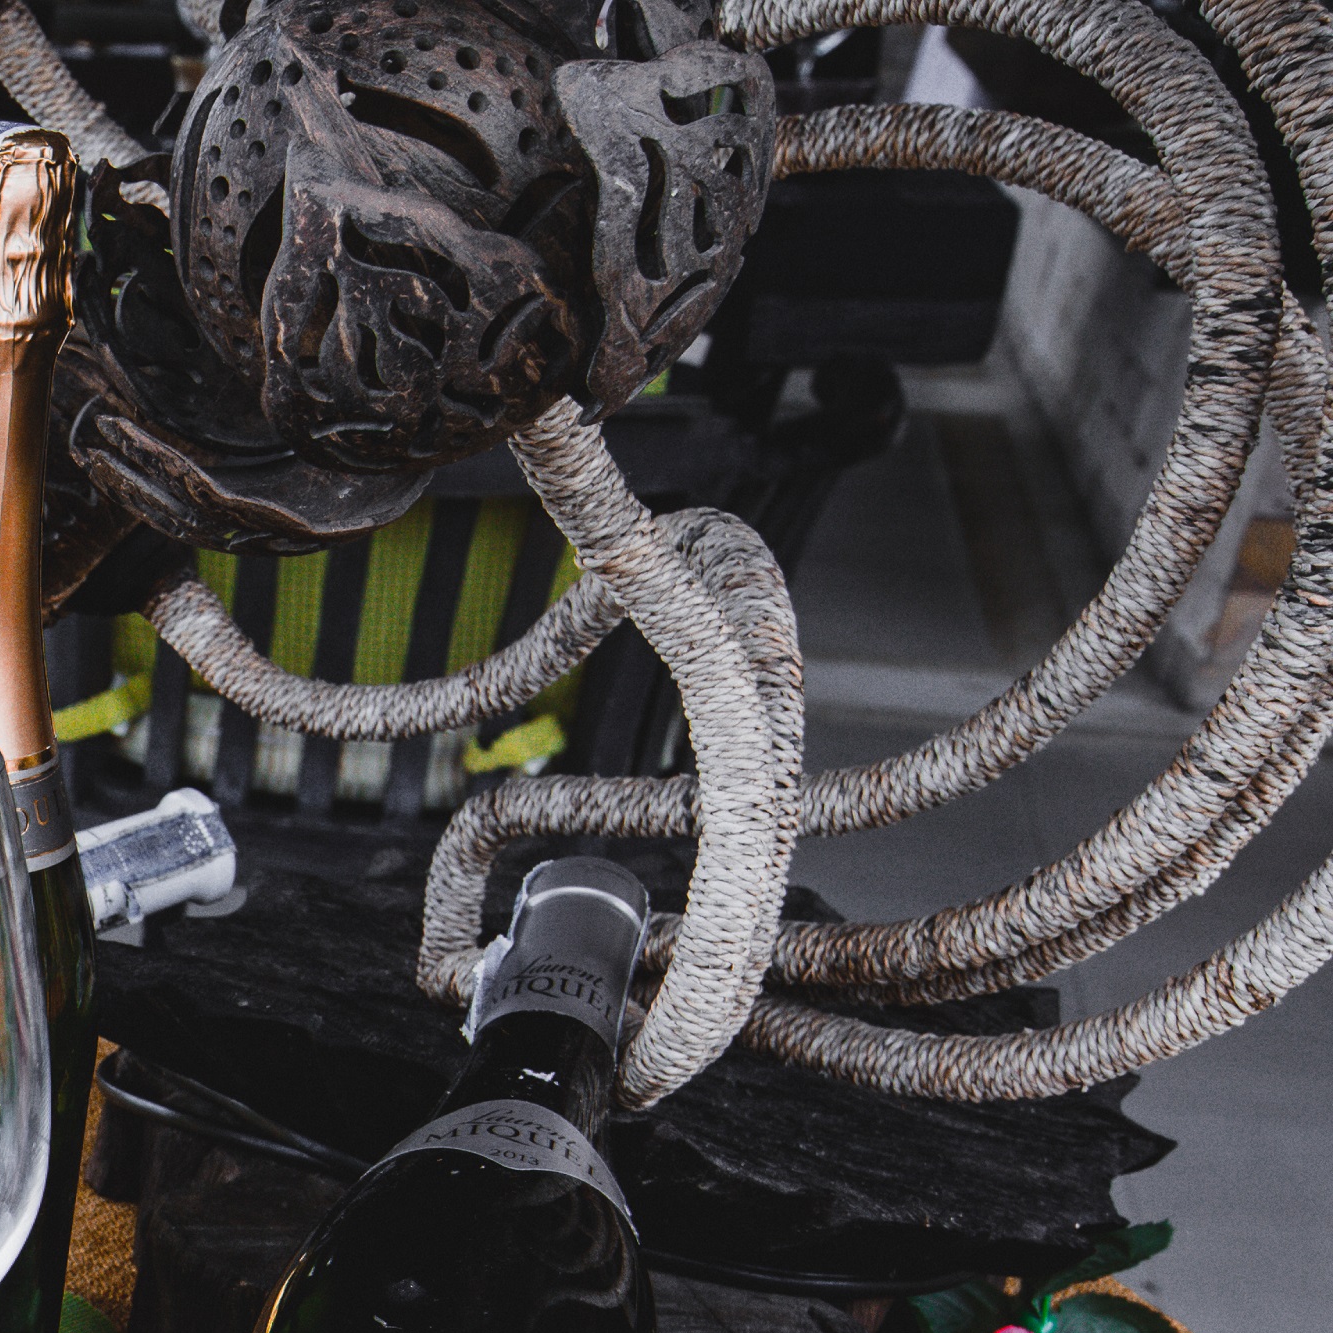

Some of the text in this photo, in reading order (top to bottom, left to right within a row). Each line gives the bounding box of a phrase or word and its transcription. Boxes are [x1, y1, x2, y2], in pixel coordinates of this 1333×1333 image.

[509, 954, 605, 988] Laurent
[490, 976, 614, 1027] MIQUEL
[457, 1109, 581, 1147] Laurent
[424, 1124, 603, 1185] MIQUEL
[489, 1148, 540, 1166] 2013
